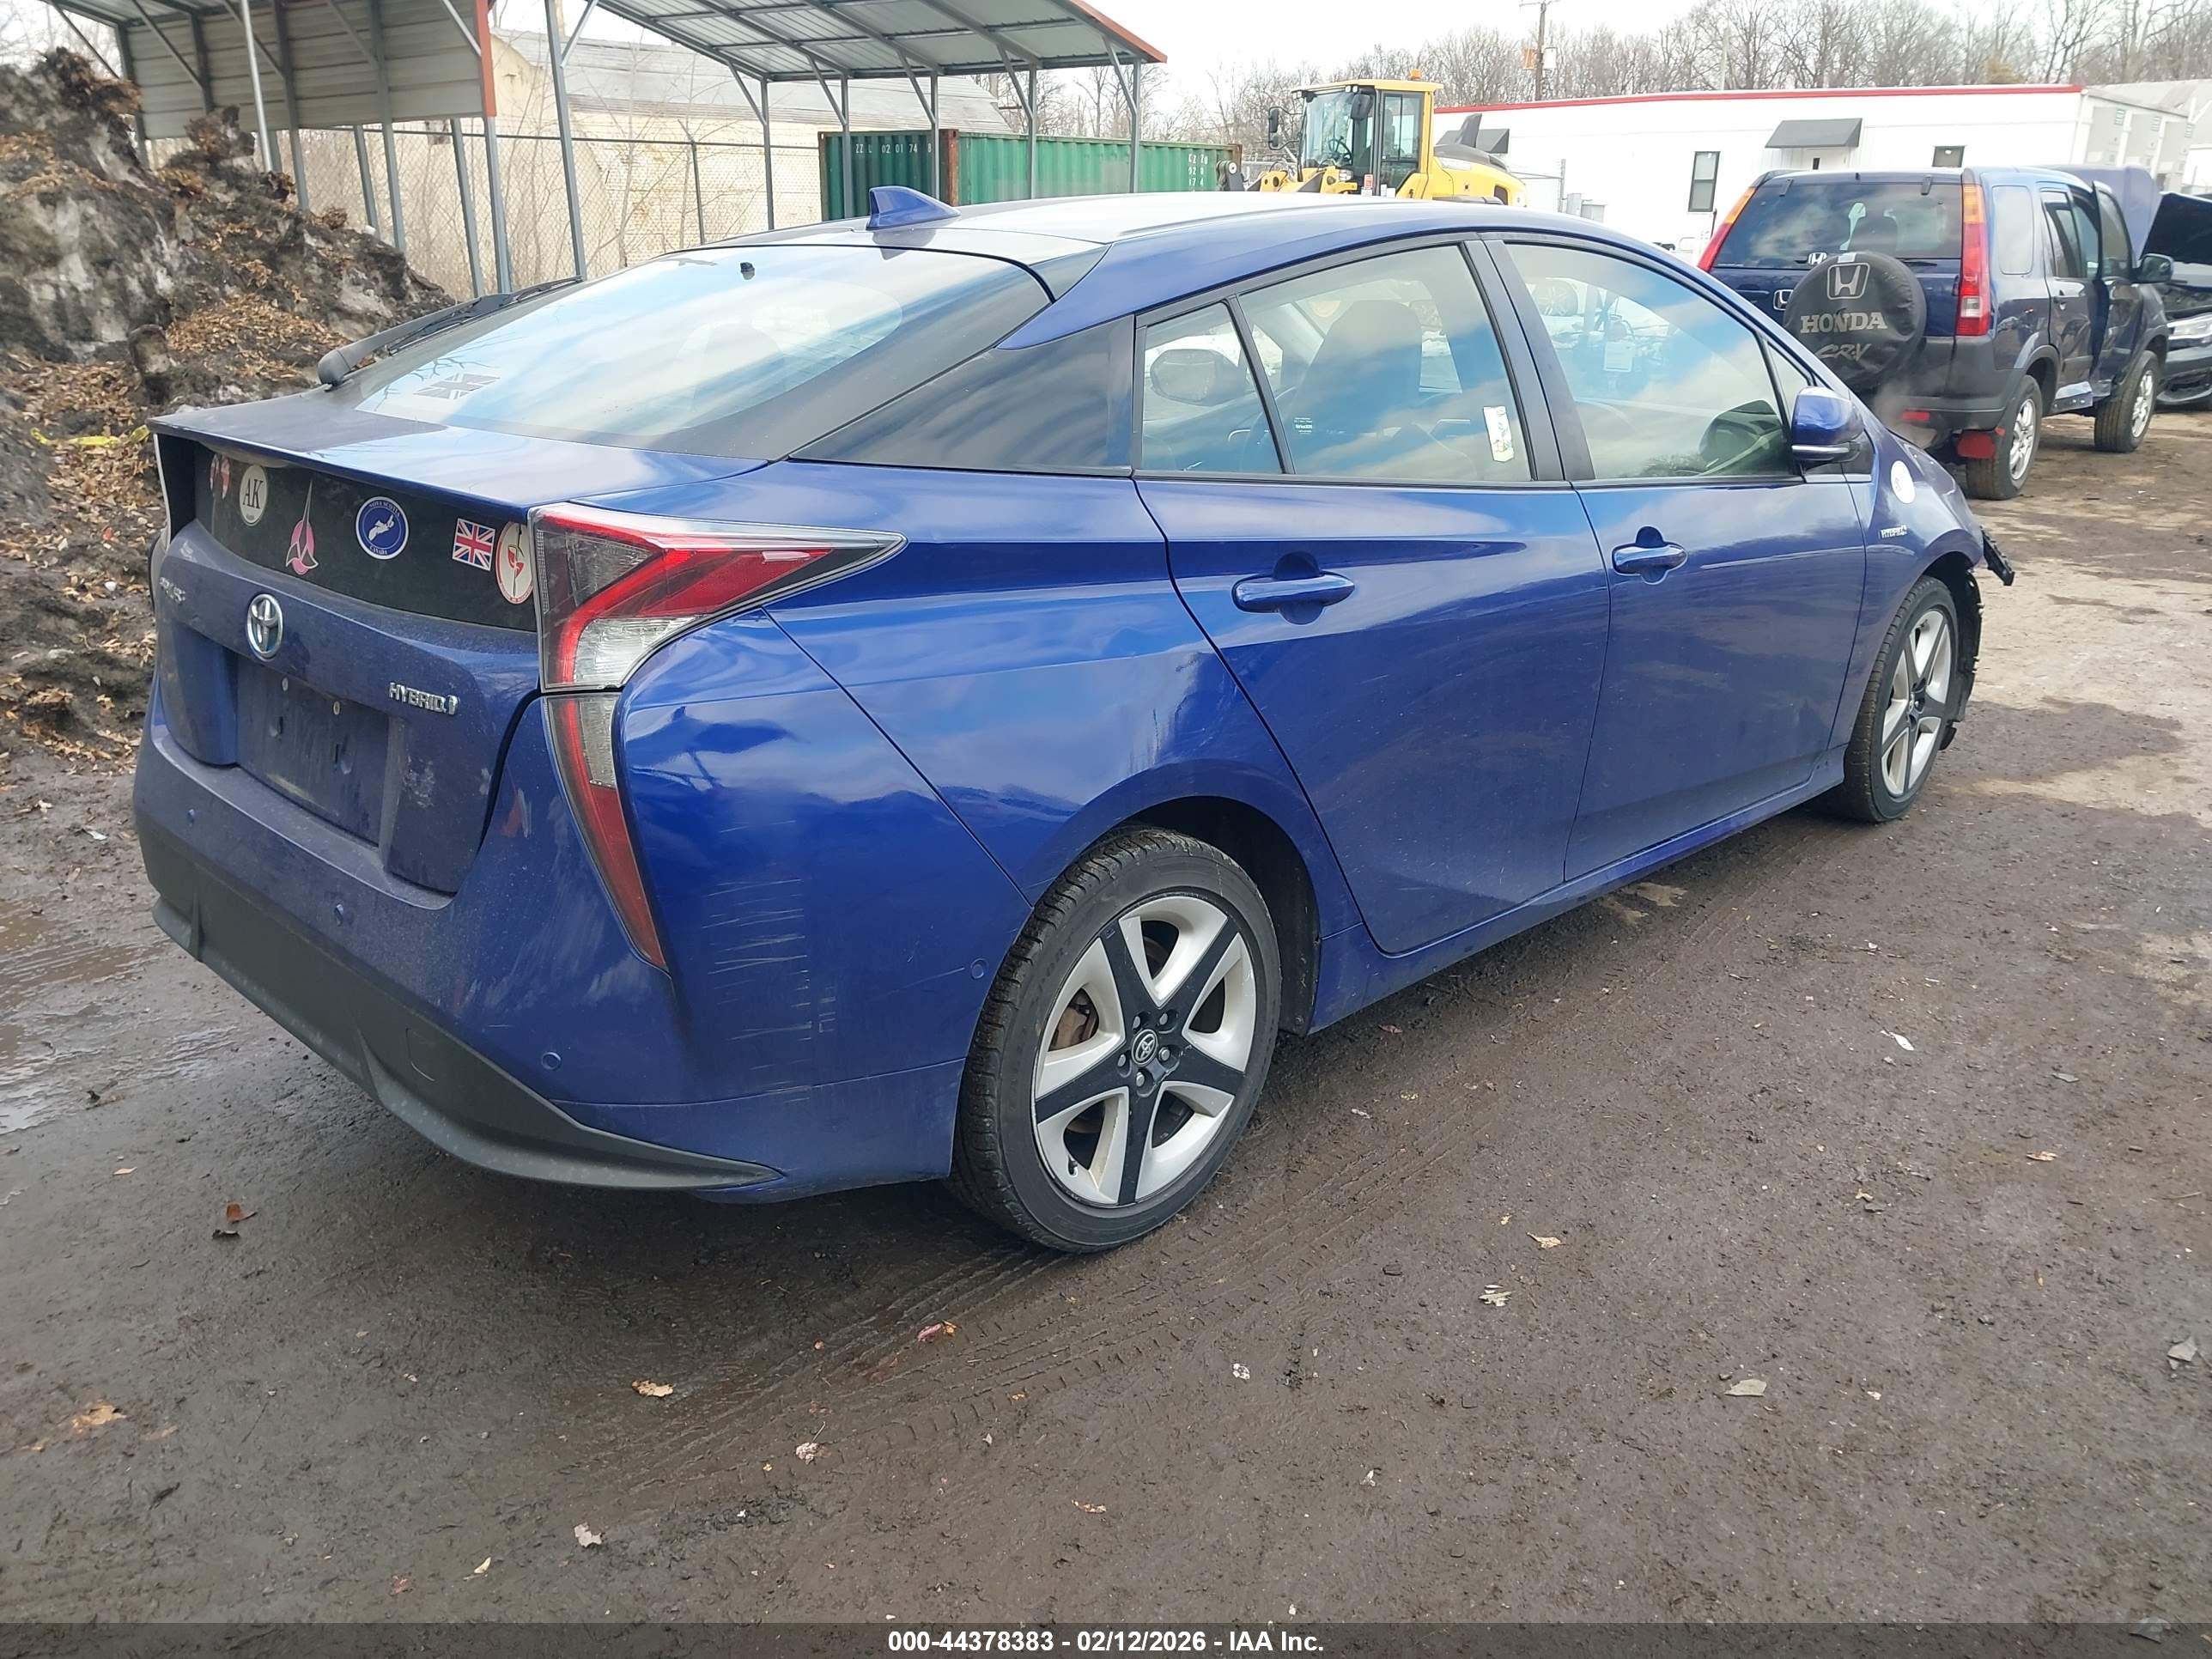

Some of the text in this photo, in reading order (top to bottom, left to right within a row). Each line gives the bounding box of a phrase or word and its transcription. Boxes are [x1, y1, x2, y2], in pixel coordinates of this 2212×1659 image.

[1800, 311, 1888, 334] HONDA
[242, 477, 264, 509] AK
[383, 501, 401, 518] SCOTIA
[369, 545, 388, 556] CANADA
[388, 682, 447, 714] HYBRID
